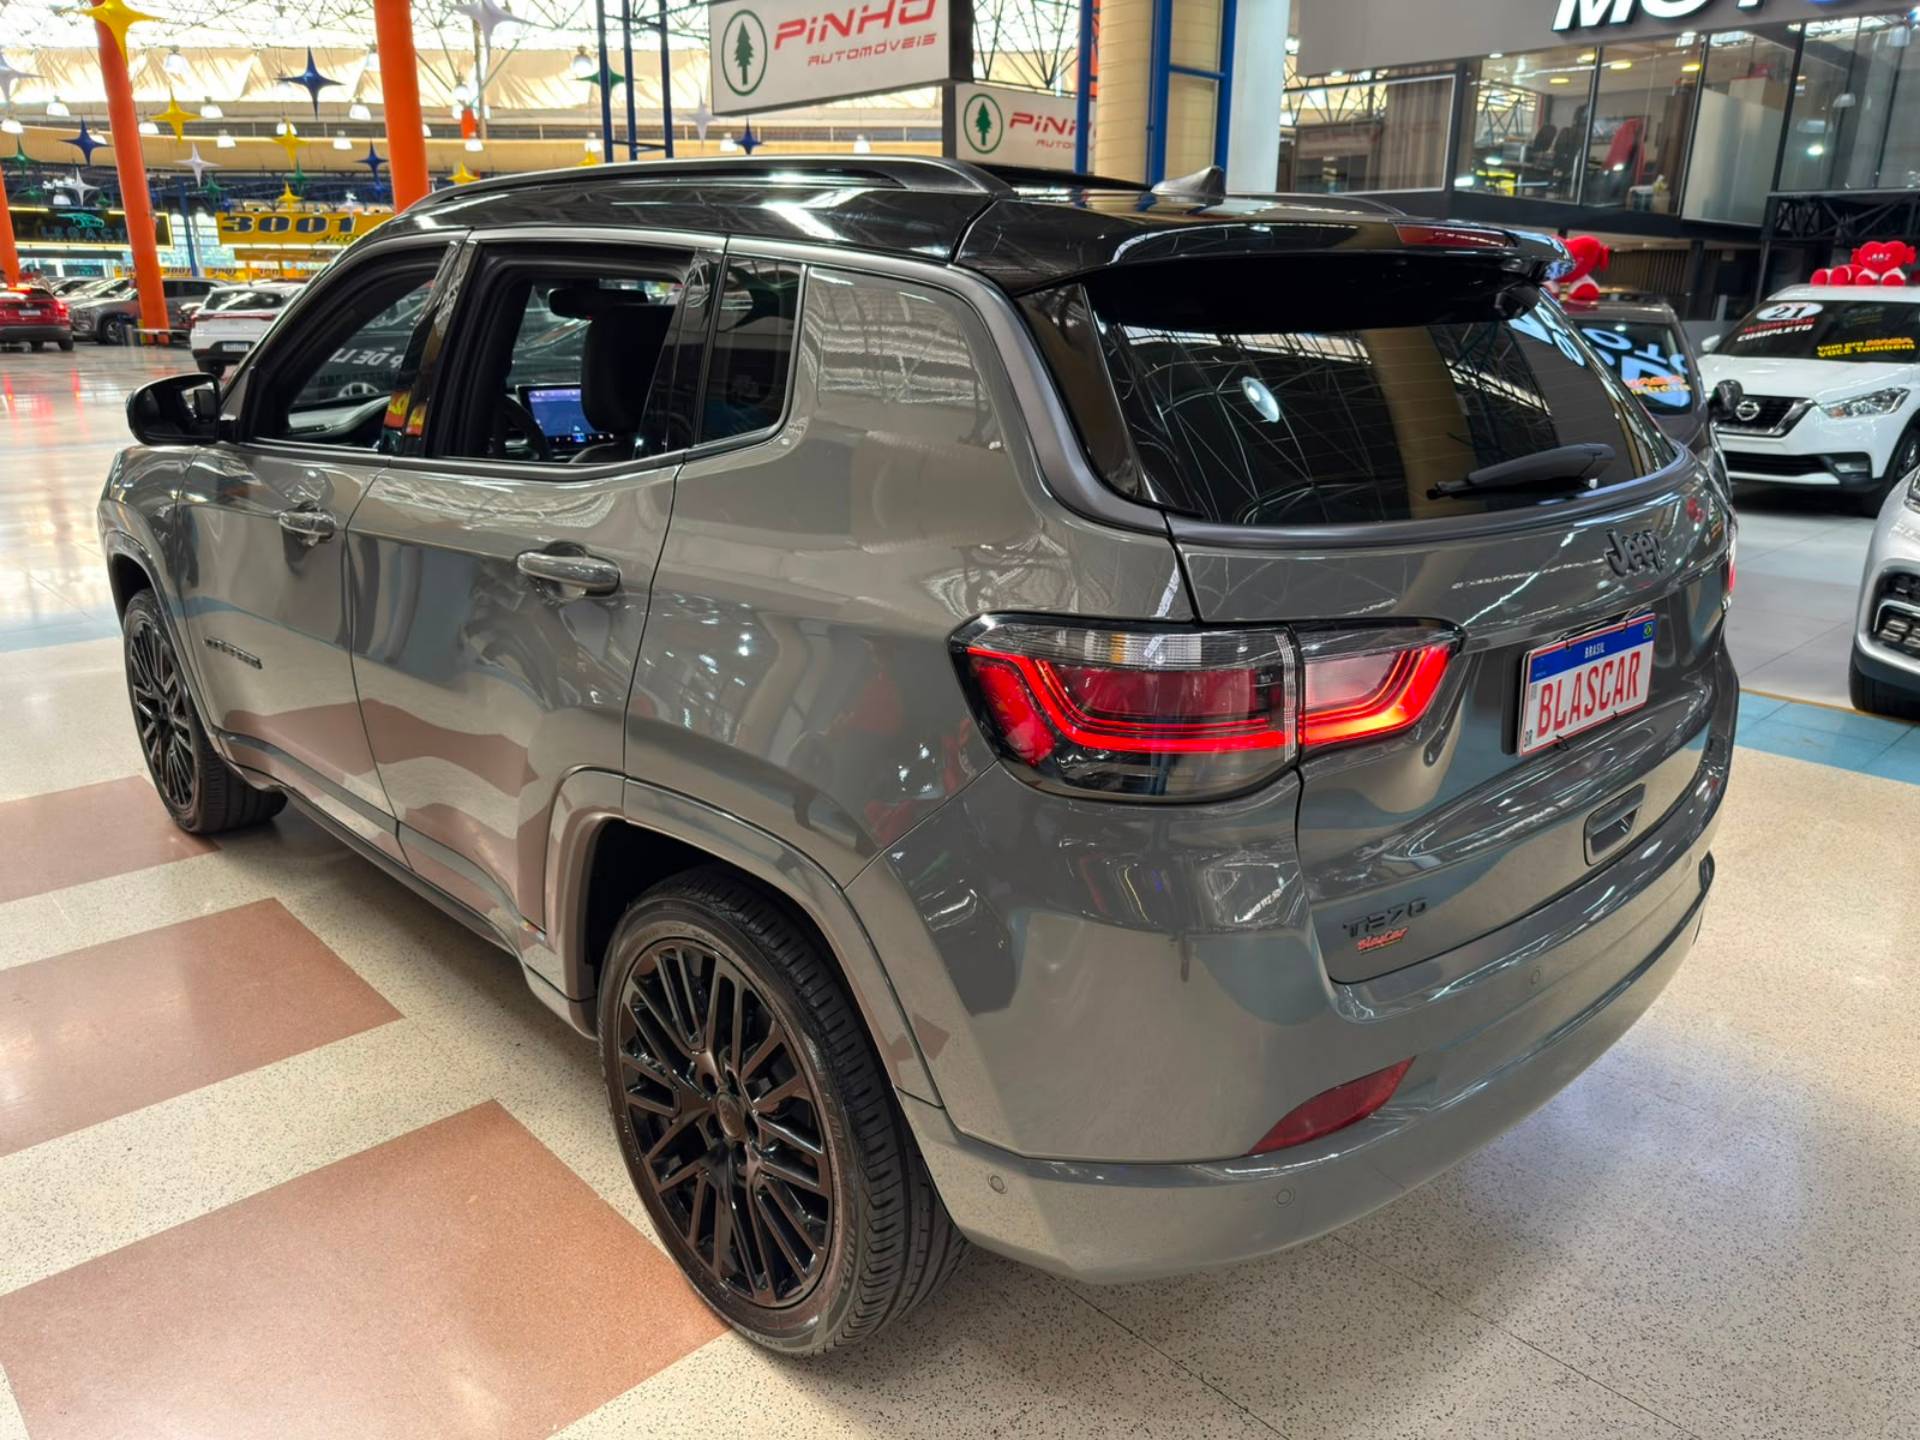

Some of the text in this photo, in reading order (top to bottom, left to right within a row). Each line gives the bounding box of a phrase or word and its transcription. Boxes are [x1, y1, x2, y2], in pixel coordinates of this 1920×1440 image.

[221, 215, 356, 234] 3001
[1767, 305, 1806, 319] 21
[1737, 324, 1814, 342] COMPLETO
[1603, 528, 1663, 577] Jeep
[1584, 641, 1605, 659] BRASIL
[1537, 651, 1641, 738] BLASCAR
